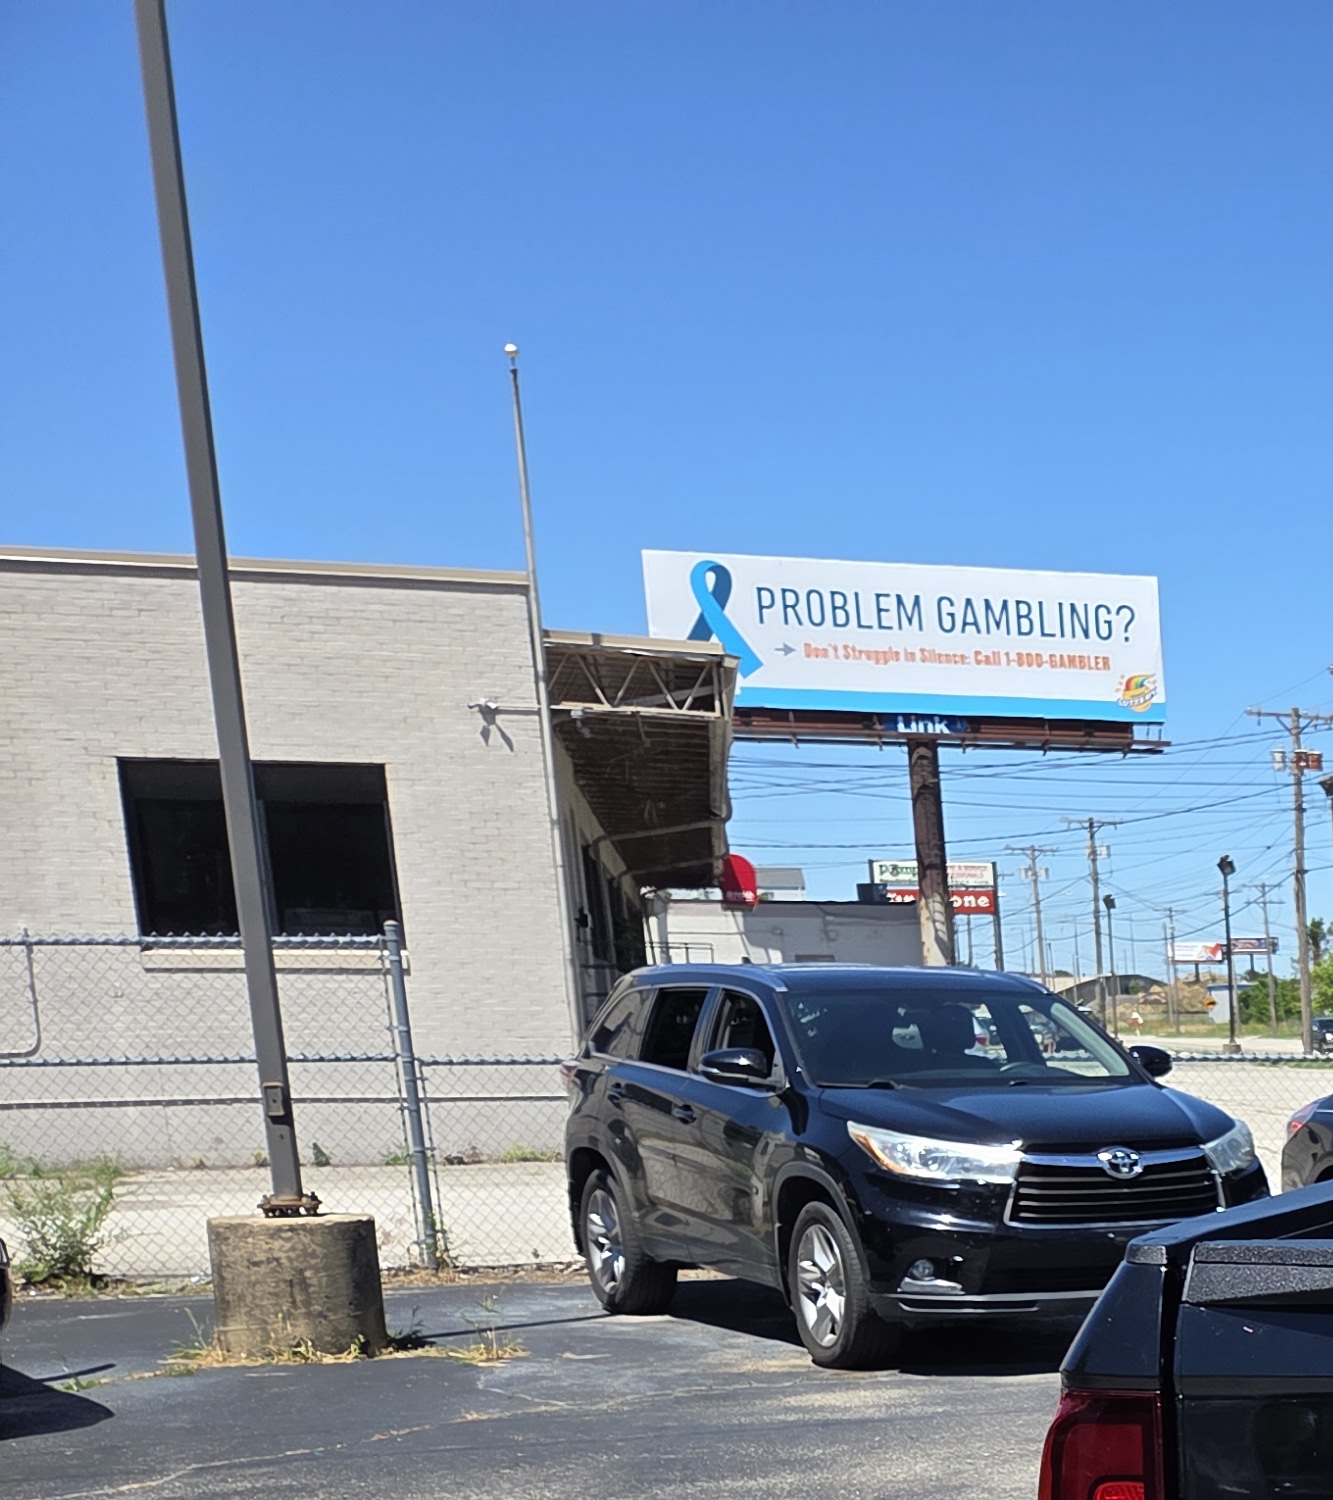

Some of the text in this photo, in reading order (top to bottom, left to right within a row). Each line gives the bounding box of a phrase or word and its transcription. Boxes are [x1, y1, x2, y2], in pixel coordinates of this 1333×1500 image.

[755, 586, 1136, 643] PROBLEM GAMBLING?
[974, 650, 1001, 667] Call
[1004, 651, 1112, 671] 1-800-GAMBLER
